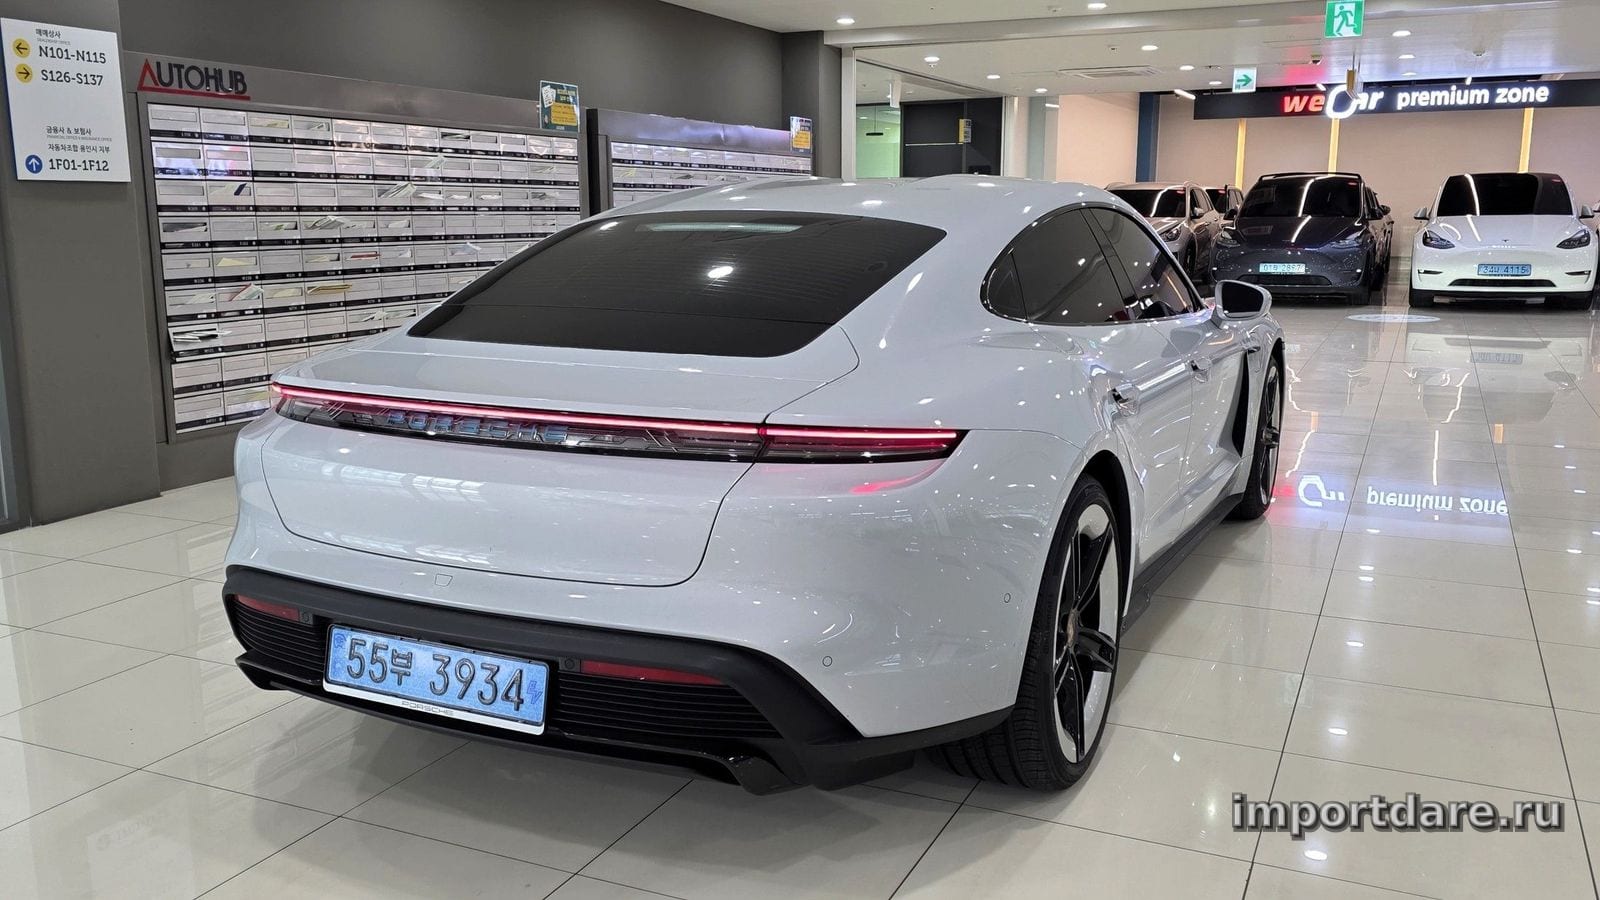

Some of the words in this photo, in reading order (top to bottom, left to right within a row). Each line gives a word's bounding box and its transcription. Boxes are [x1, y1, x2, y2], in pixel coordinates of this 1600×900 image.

[36, 28, 61, 39] 매매상사
[38, 45, 106, 64] N101-N115
[41, 69, 103, 86] S126-S137
[137, 58, 248, 96] AUTOHUB
[1397, 84, 1490, 110] premium
[1495, 85, 1550, 104] zone
[46, 125, 65, 135] 금융사
[73, 127, 92, 136] 보험사
[48, 143, 78, 152] 자동차조합
[49, 158, 109, 172] 1F01-1F12
[346, 638, 413, 686] 55부
[429, 653, 524, 711] 3934
[401, 700, 454, 717] PORSCHE
